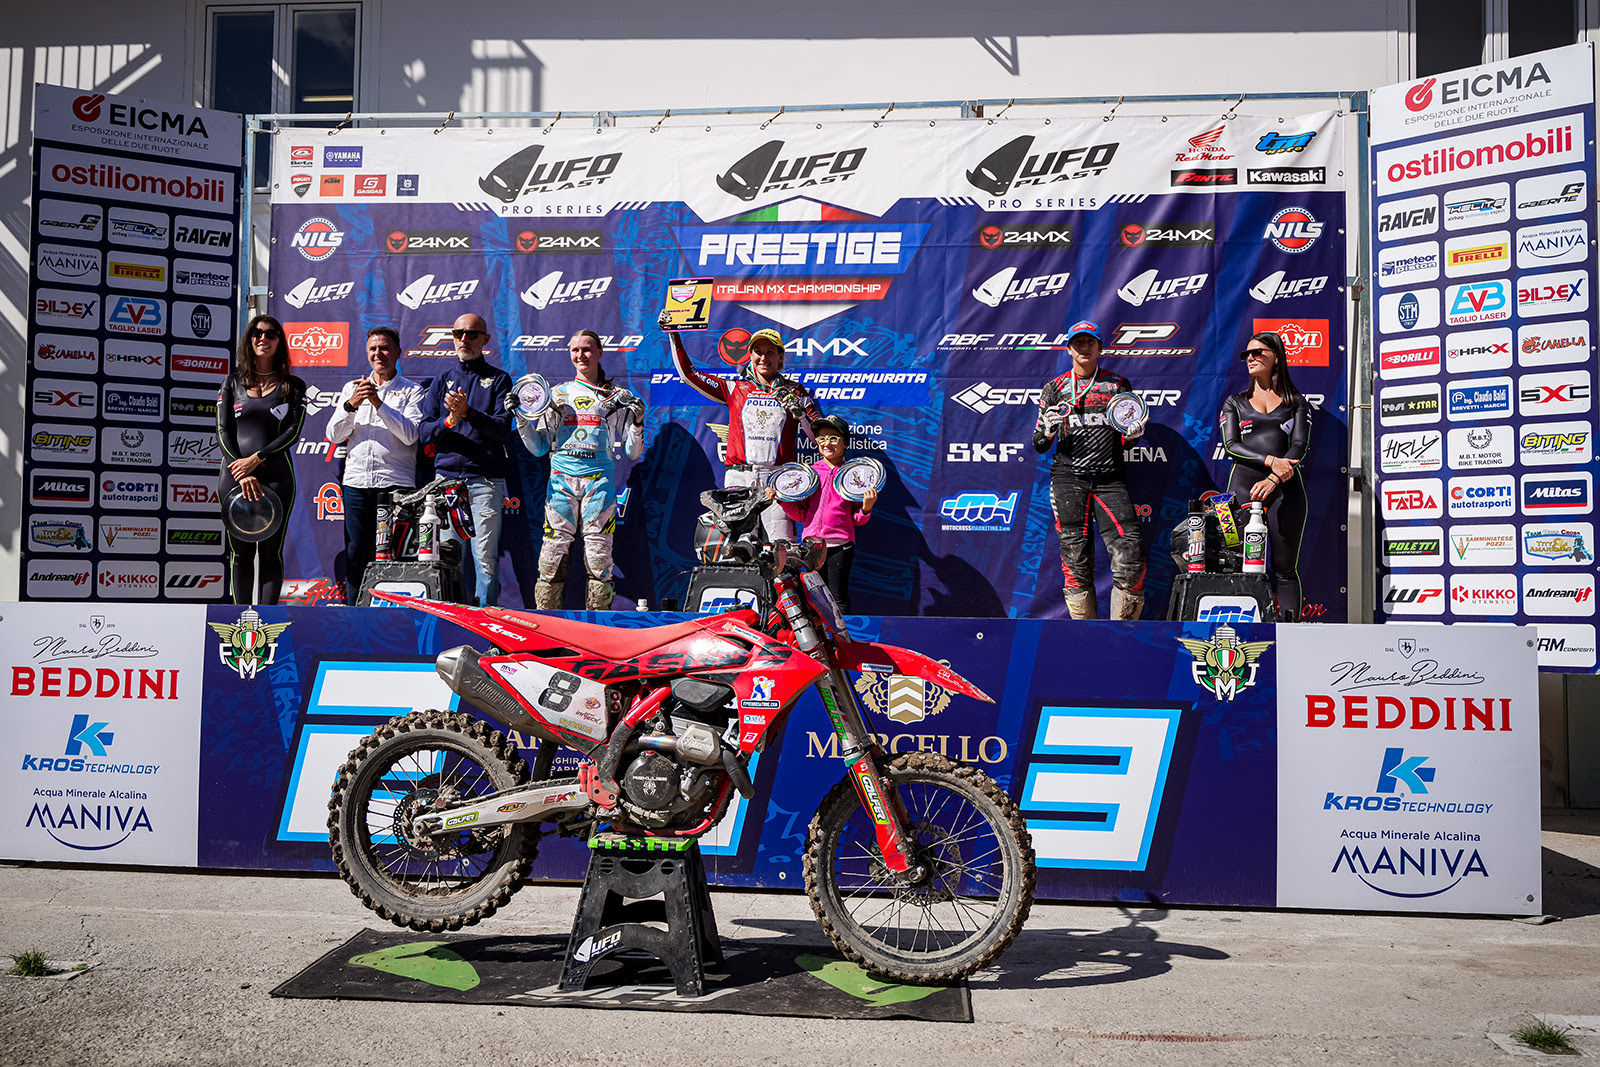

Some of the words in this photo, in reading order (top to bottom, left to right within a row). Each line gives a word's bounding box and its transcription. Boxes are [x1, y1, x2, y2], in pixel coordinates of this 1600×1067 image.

[1441, 61, 1552, 105] EICMA
[1404, 106, 1466, 126] ESPOSIZIONE
[1467, 88, 1552, 113] INTERNAZIONALE
[109, 103, 210, 139] EICMA
[1433, 116, 1462, 129] DELLE
[1464, 111, 1484, 122] DUE
[1486, 105, 1520, 119] RUOTE
[71, 124, 132, 142] ESPOSIZIONE
[134, 134, 209, 150] INTERNAZIONALE
[101, 137, 128, 148] DELLE
[131, 140, 148, 150] DUE
[151, 143, 180, 154] RUOTE
[1187, 145, 1227, 153] HONDA
[334, 151, 360, 160] YAMAHA
[1017, 142, 1120, 178] UFO
[1386, 125, 1573, 184] ostiliomobili
[529, 150, 623, 189] UFO
[768, 147, 869, 184] UFO
[51, 163, 225, 203] ostiliomobili
[762, 172, 857, 194] PLAST
[1012, 167, 1109, 188] PLAST
[1173, 171, 1234, 183] FANTIC
[1249, 169, 1324, 184] Kawasaki
[522, 175, 612, 196] PLAST
[501, 205, 534, 214] PRO
[545, 204, 604, 214] SERIES
[987, 199, 1022, 208] PRO
[1035, 197, 1098, 208] SERIES
[1378, 206, 1438, 233] RAVEN
[174, 226, 233, 248] RAVEN
[1003, 229, 1071, 243] 24MX
[1145, 228, 1215, 243] 24MX
[1262, 221, 1324, 240] NILS
[290, 231, 346, 250] NILS
[406, 234, 471, 250] 24MX
[537, 234, 601, 249] 24MX
[1517, 234, 1587, 254] MANIVA
[698, 231, 903, 266] PRESTIGE
[1452, 246, 1504, 264] PIRELLI
[38, 256, 101, 273] MANIVA
[1396, 253, 1438, 267] meteor
[114, 263, 161, 279] PIRELLI
[1395, 261, 1438, 275] piston
[190, 271, 230, 282] meteor
[190, 278, 230, 288] piston
[1009, 271, 1072, 296] UFO
[310, 281, 356, 298] UFO
[429, 279, 480, 298] UFO
[559, 275, 614, 297] UFO
[715, 285, 764, 294] ITALIAN
[766, 285, 784, 294] MX
[787, 284, 882, 294] CHAMPIONSHIP
[1152, 273, 1210, 296] UFO
[1279, 274, 1330, 296] UFO
[305, 293, 346, 304] PLAST
[422, 293, 473, 304] PLAST
[551, 292, 607, 305] PLAST
[1002, 287, 1064, 303] PLAST
[1144, 288, 1203, 303] PLAST
[1271, 288, 1326, 302] PLAST
[685, 298, 706, 323] 1
[1398, 305, 1418, 320] STM
[192, 314, 212, 324] STM
[1449, 315, 1478, 326] TAGLIO
[1479, 311, 1508, 322] LASER
[108, 323, 134, 332] TAGLIO
[135, 325, 162, 334] LASER
[289, 334, 340, 349] CAMI
[512, 334, 567, 348] ABF
[937, 333, 998, 347] ABF
[1101, 348, 1193, 357] PROGRIP
[1393, 350, 1435, 366] BORILLI
[184, 358, 224, 371] BORILLI
[803, 372, 928, 384] PIETRAMURATA
[813, 387, 867, 400] ARCO
[1473, 390, 1492, 404] Claudio
[1492, 388, 1506, 402] Baldi
[746, 399, 782, 410] POLIZIA
[1415, 399, 1438, 410] STAR
[1451, 403, 1480, 412] BREVETTI
[1483, 401, 1508, 410] MARCHI
[33, 432, 97, 450] BITING
[1520, 432, 1592, 449] BITING
[946, 443, 1024, 462] SKF
[1458, 452, 1476, 460] M.B.T.
[1478, 451, 1502, 460] MOTOR
[1457, 459, 1472, 468] BIKE
[1473, 458, 1504, 466] TRADING
[116, 481, 159, 494] CORTI
[1465, 486, 1512, 499] CORTI
[102, 493, 160, 504] autotrasporti
[1450, 497, 1513, 511] autotrasporti
[171, 530, 220, 540] POLETTI
[1387, 540, 1438, 552] POLETTI
[29, 571, 79, 582] Andreani
[117, 574, 159, 584] KIKKO
[1471, 588, 1517, 600] KIKKO
[1524, 587, 1580, 600] Andreani
[9, 665, 181, 700] BEDDINI
[537, 671, 582, 713] 8
[1304, 694, 1514, 732] BEDDINI
[33, 787, 64, 798] Acqua
[65, 787, 107, 798] Minerale
[108, 789, 148, 800] Alcalina
[25, 802, 155, 832] MANIVA
[1340, 828, 1378, 842] Acqua
[1380, 829, 1431, 842] Minerale
[1433, 831, 1482, 842] Alcalina
[1330, 845, 1491, 878] MANIVA
[592, 930, 622, 953] UFO
